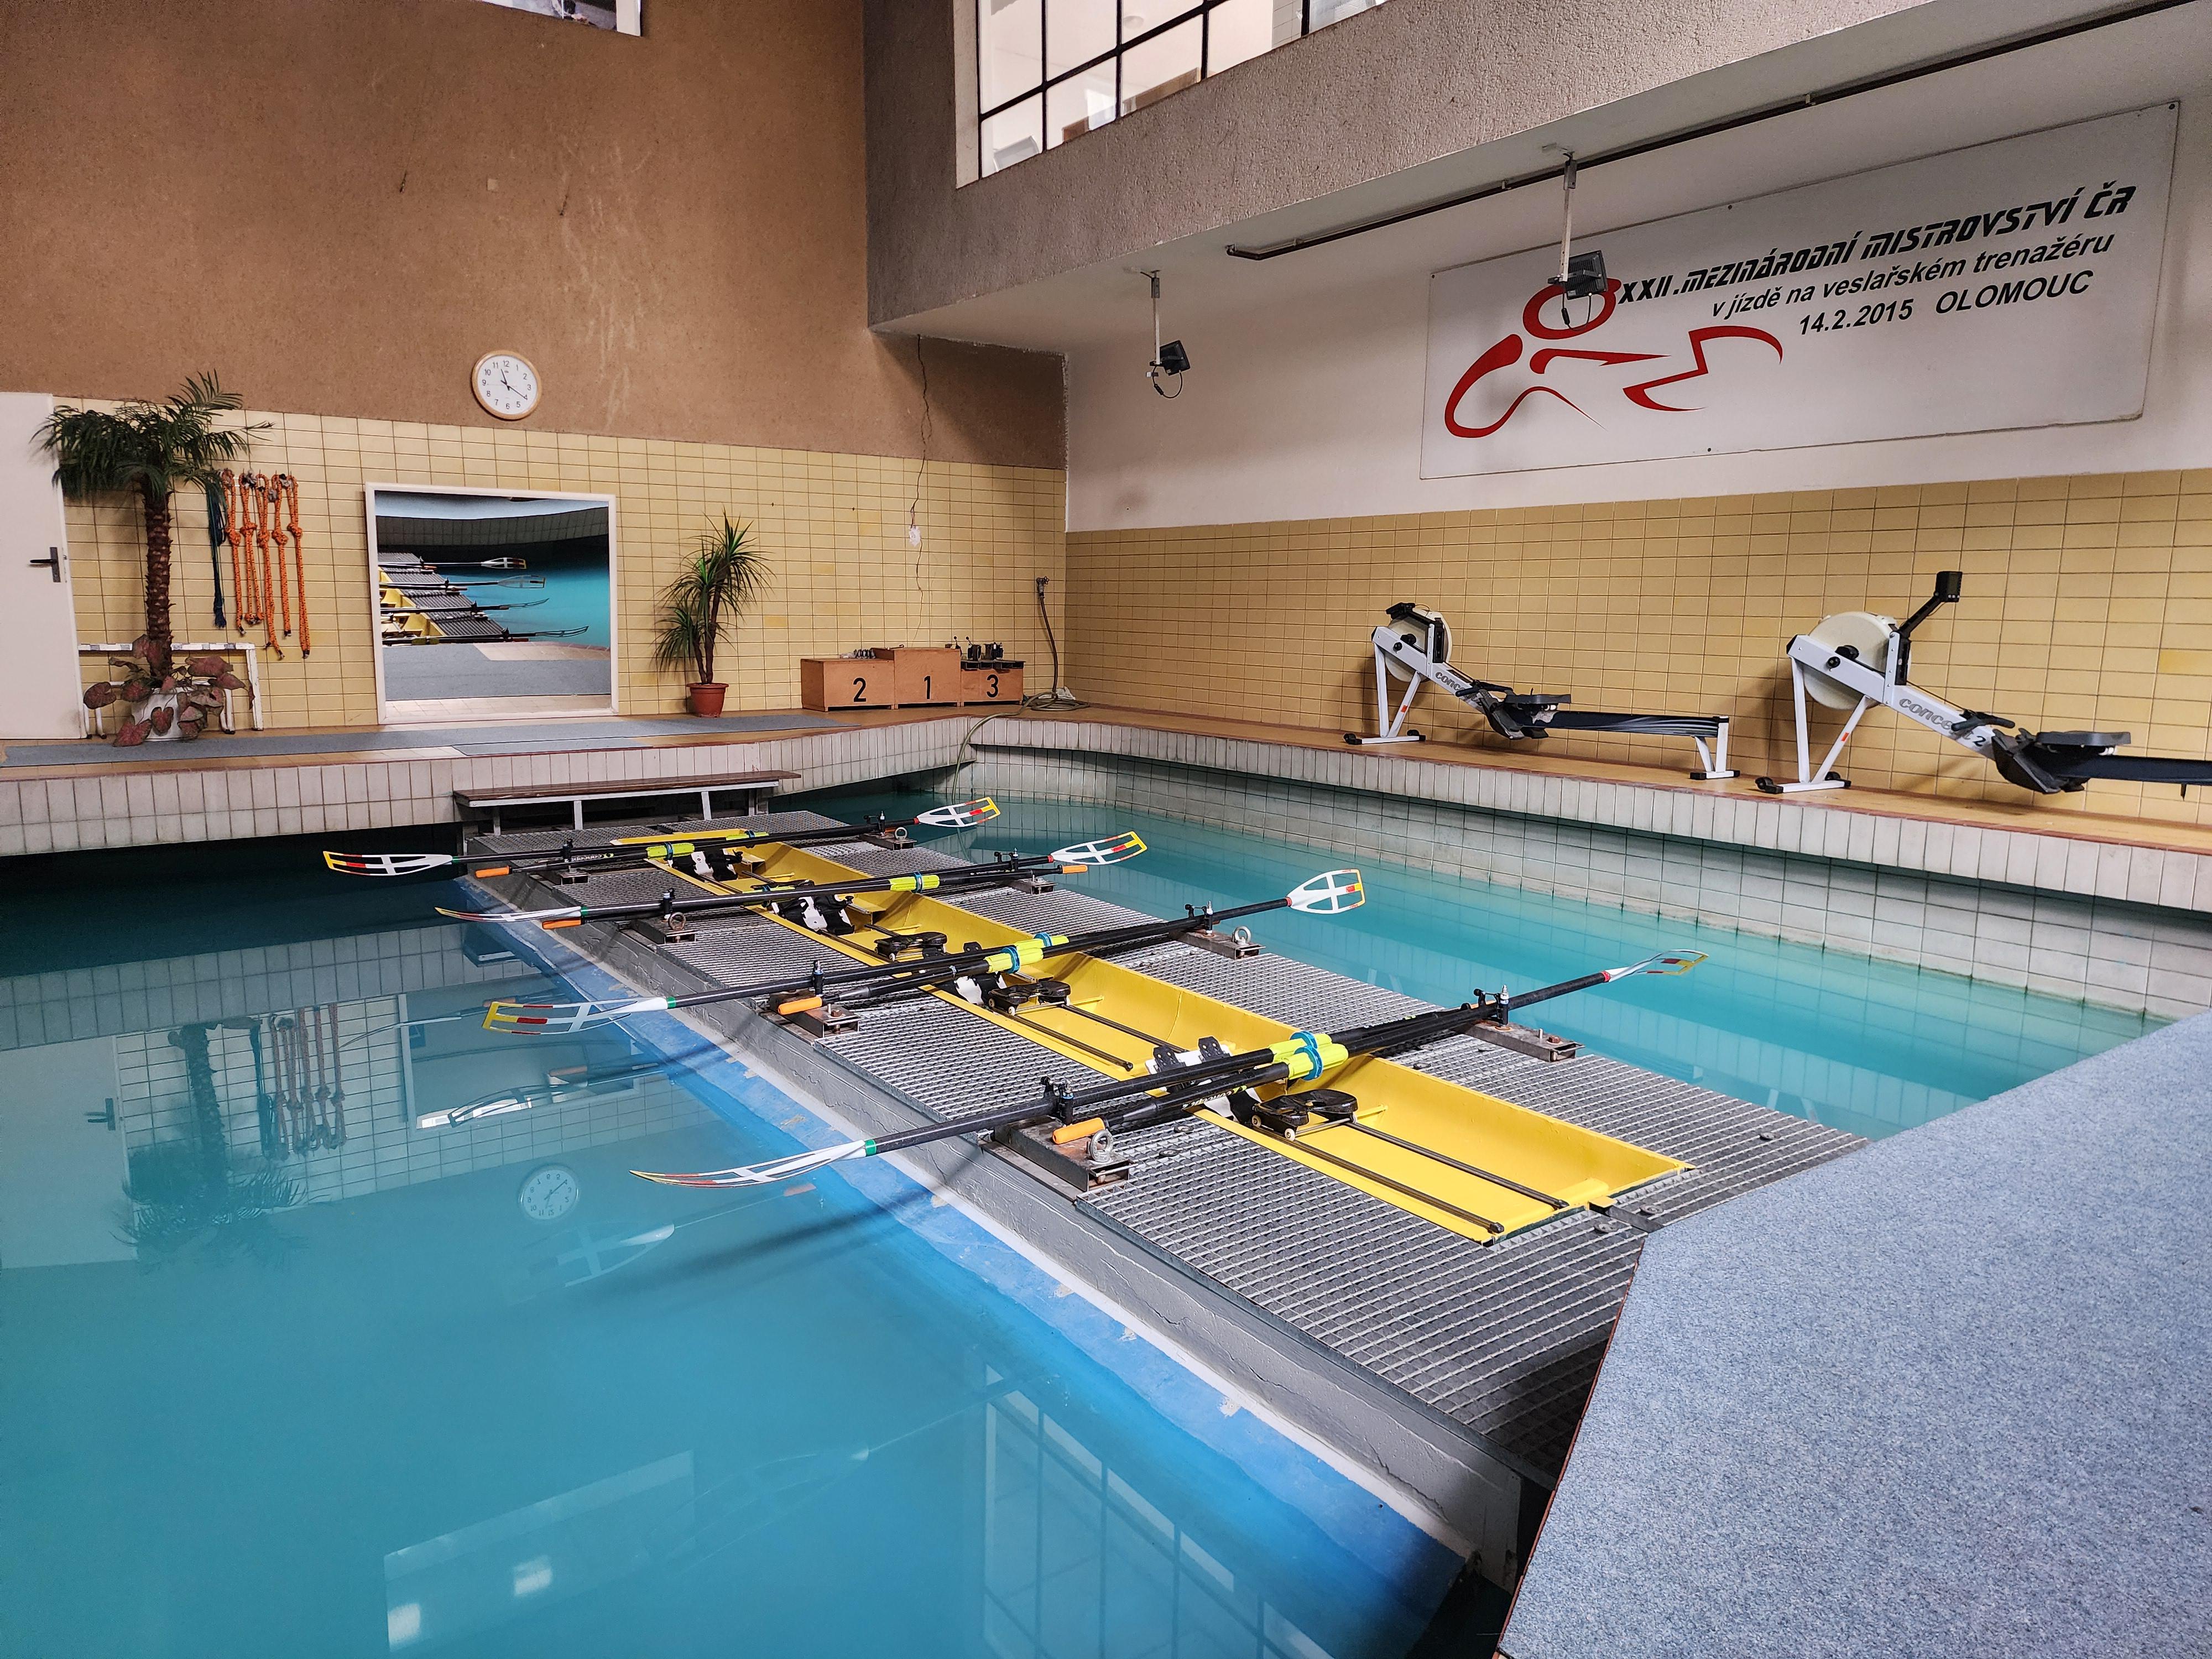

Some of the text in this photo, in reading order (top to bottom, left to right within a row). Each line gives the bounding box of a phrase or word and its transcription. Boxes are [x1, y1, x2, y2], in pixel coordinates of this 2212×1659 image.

[1860, 186, 2085, 260] MISTROVSTVÍ
[2083, 180, 2136, 220] ČR
[1713, 233, 2115, 320] v jízdě na veslařském trenažéru
[1799, 270, 2094, 335] 14.2.2015 OLOMOUC
[853, 677, 867, 702] 2
[924, 675, 931, 700] 1
[986, 674, 999, 698] 3
[1973, 735, 1986, 747] 2
